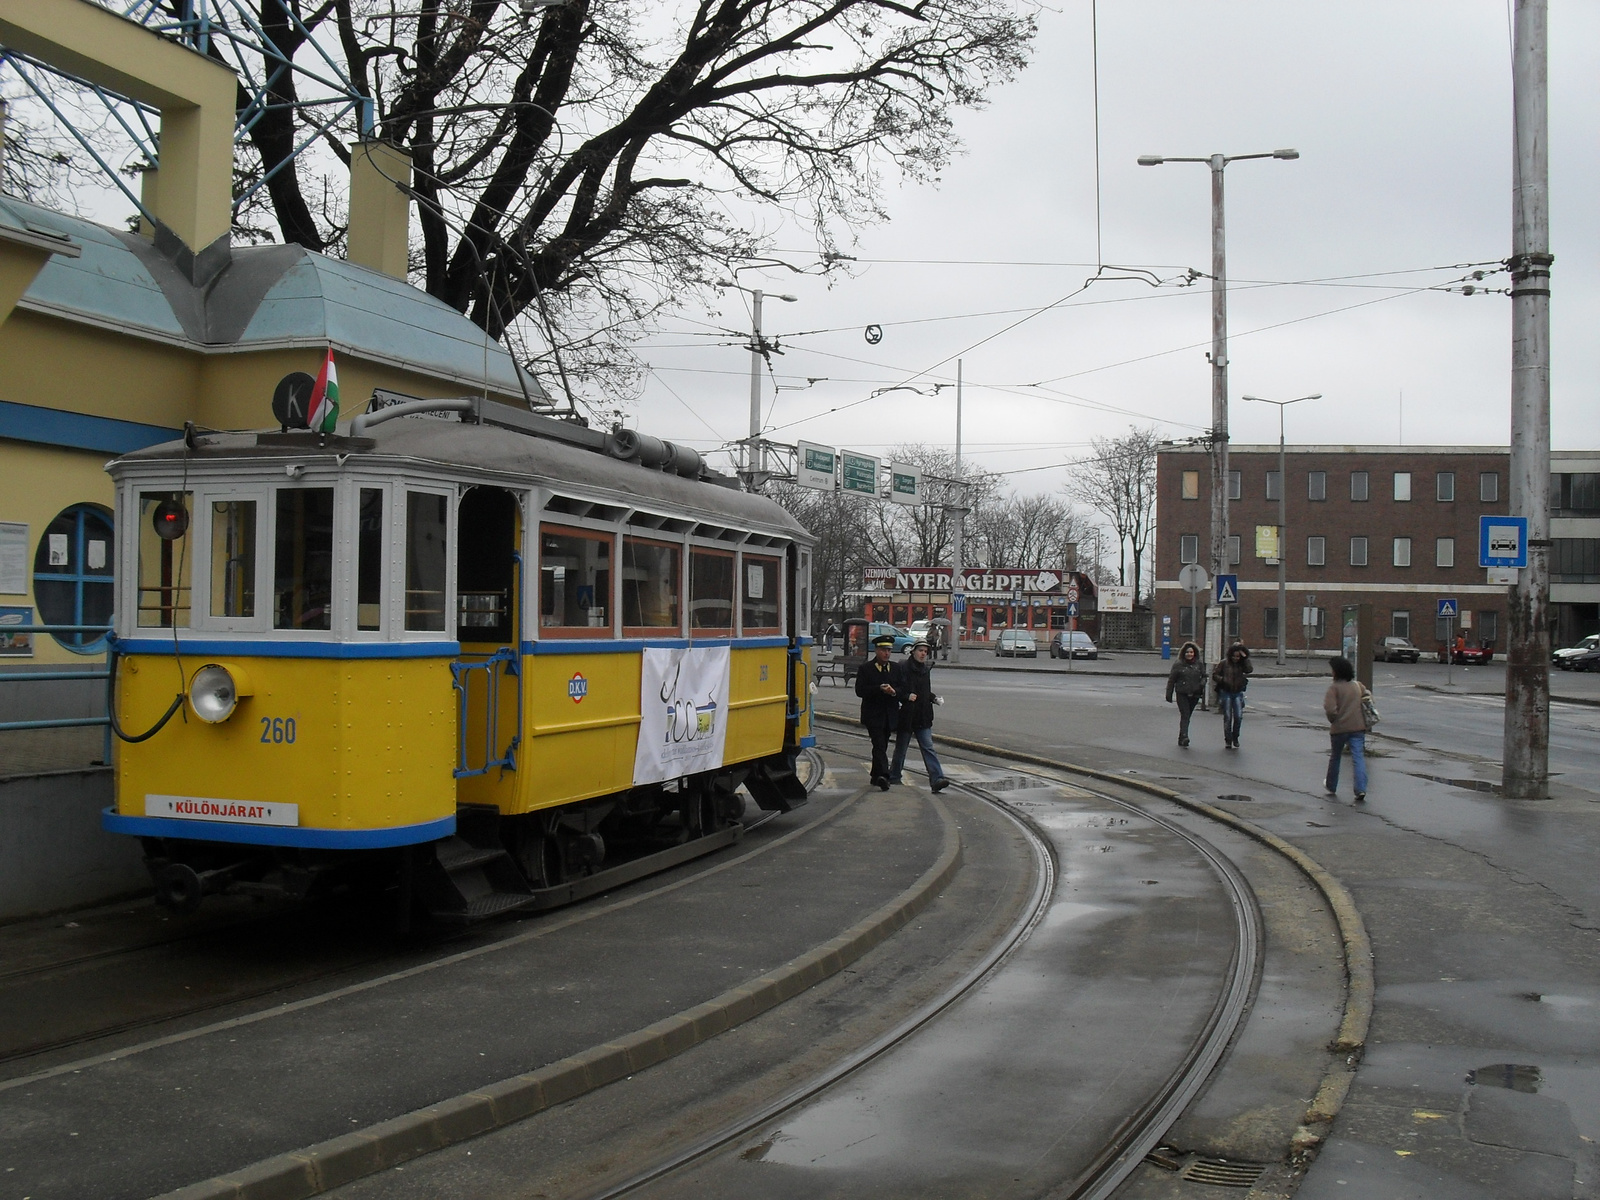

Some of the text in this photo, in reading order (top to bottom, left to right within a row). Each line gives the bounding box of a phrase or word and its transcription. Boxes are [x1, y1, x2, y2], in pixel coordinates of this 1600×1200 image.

[287, 383, 304, 418] K
[260, 717, 297, 744] 260
[175, 800, 265, 819] KÜLÖNJÁRAT
